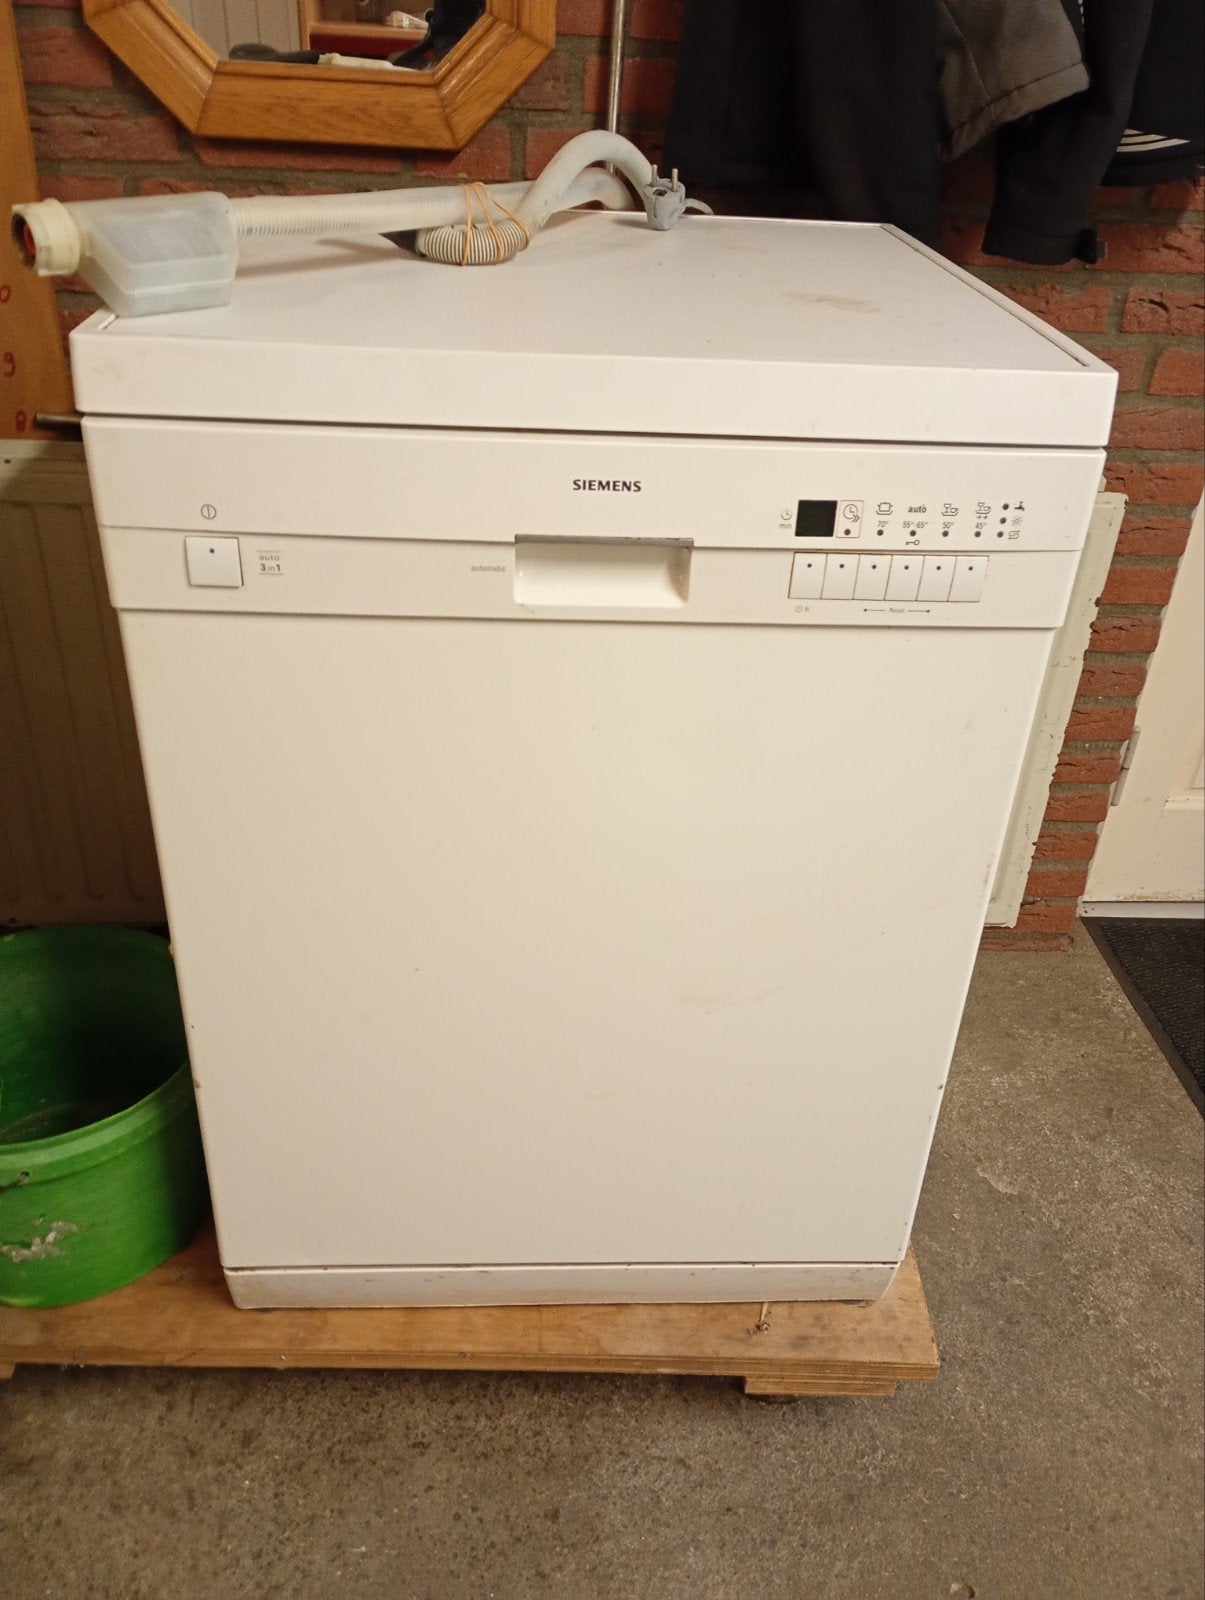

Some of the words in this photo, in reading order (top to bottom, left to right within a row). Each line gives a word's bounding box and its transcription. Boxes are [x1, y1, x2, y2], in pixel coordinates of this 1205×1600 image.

[572, 479, 642, 492] SIEMENS
[907, 504, 927, 513] auto
[470, 564, 506, 573] automatic
